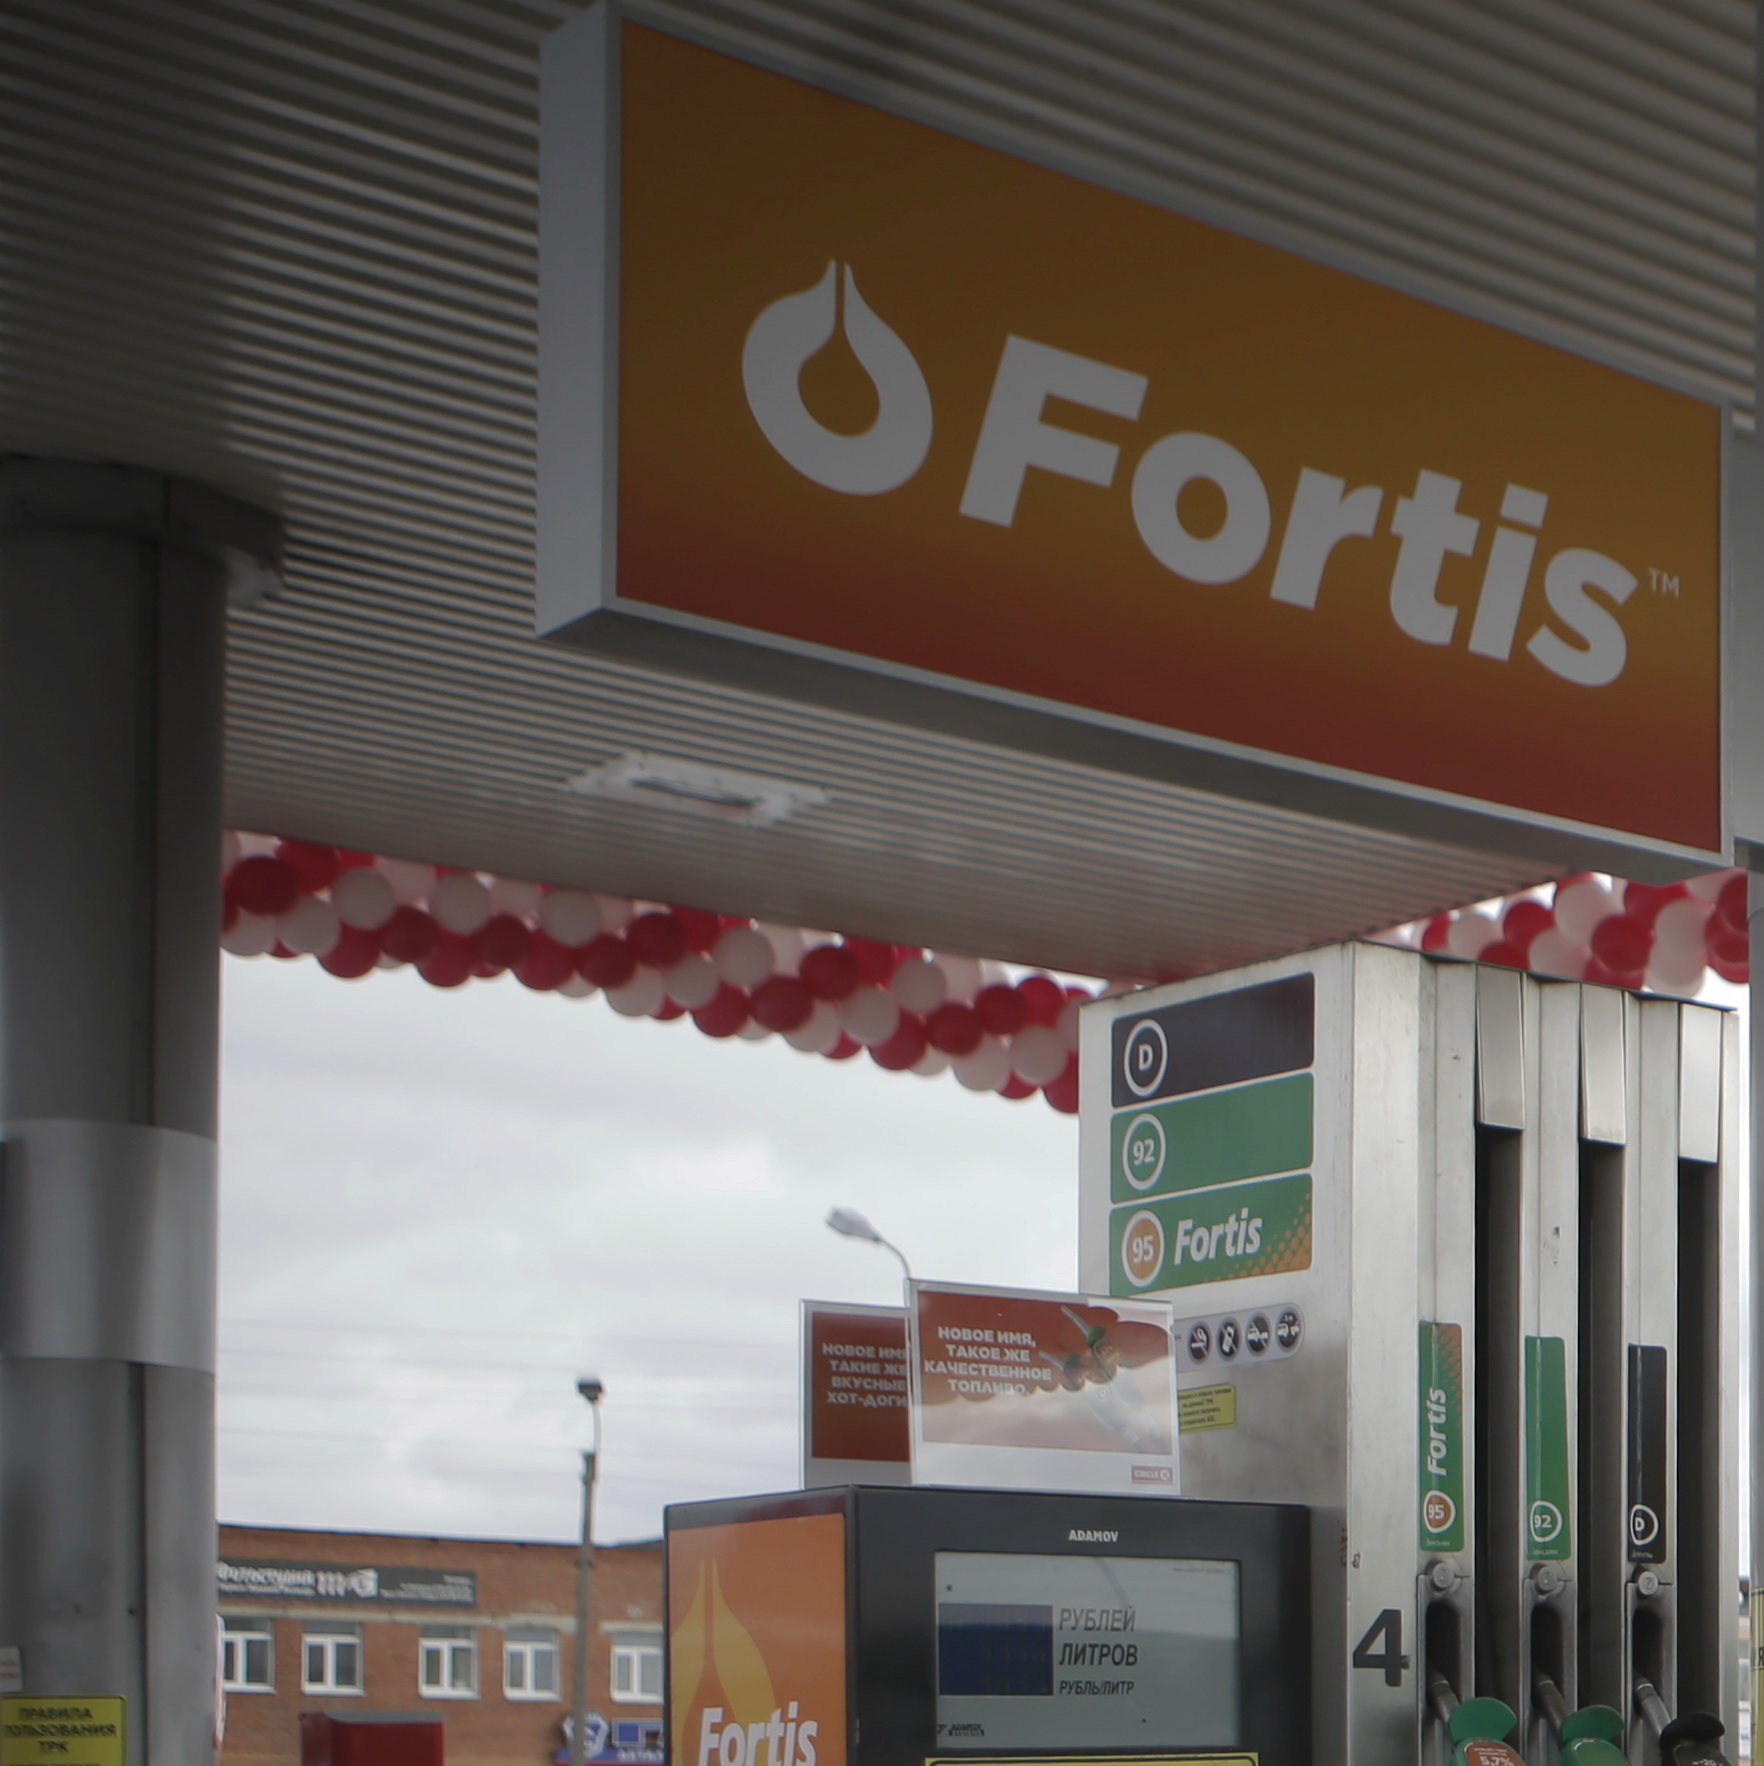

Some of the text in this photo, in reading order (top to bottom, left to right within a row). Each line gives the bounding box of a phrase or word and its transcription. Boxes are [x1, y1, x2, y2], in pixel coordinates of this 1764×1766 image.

[958, 333, 1639, 688] Fortis
[1139, 1045, 1152, 1070] D
[1132, 1138, 1156, 1164] 92
[1131, 1207, 1263, 1266] 95 Fortis
[938, 1326, 1036, 1347] НОВОЕ ИМЯ,
[822, 1343, 875, 1358] НОВОЕ
[946, 1344, 1030, 1362] ТАКОЕ ЖЕ
[829, 1360, 881, 1374] ТАКИЕ
[924, 1359, 1052, 1381] КАЧЕСТВЕННОЕ
[832, 1376, 906, 1391] ВКУСНЫЕ
[827, 1391, 907, 1408] ХОТ-ДОГИ
[1427, 1387, 1447, 1476] Fortis
[1428, 1504, 1445, 1519] 95
[1533, 1514, 1552, 1528] 92
[1635, 1518, 1645, 1531] D
[1069, 1530, 1118, 1542] ADAMOV
[1059, 1605, 1135, 1632] РУБЛЕЙ
[1059, 1643, 1138, 1666] ЛИТРОВ
[1352, 1609, 1404, 1687] 4
[1059, 1681, 1135, 1695] РУБЛЬ/ЛИТР
